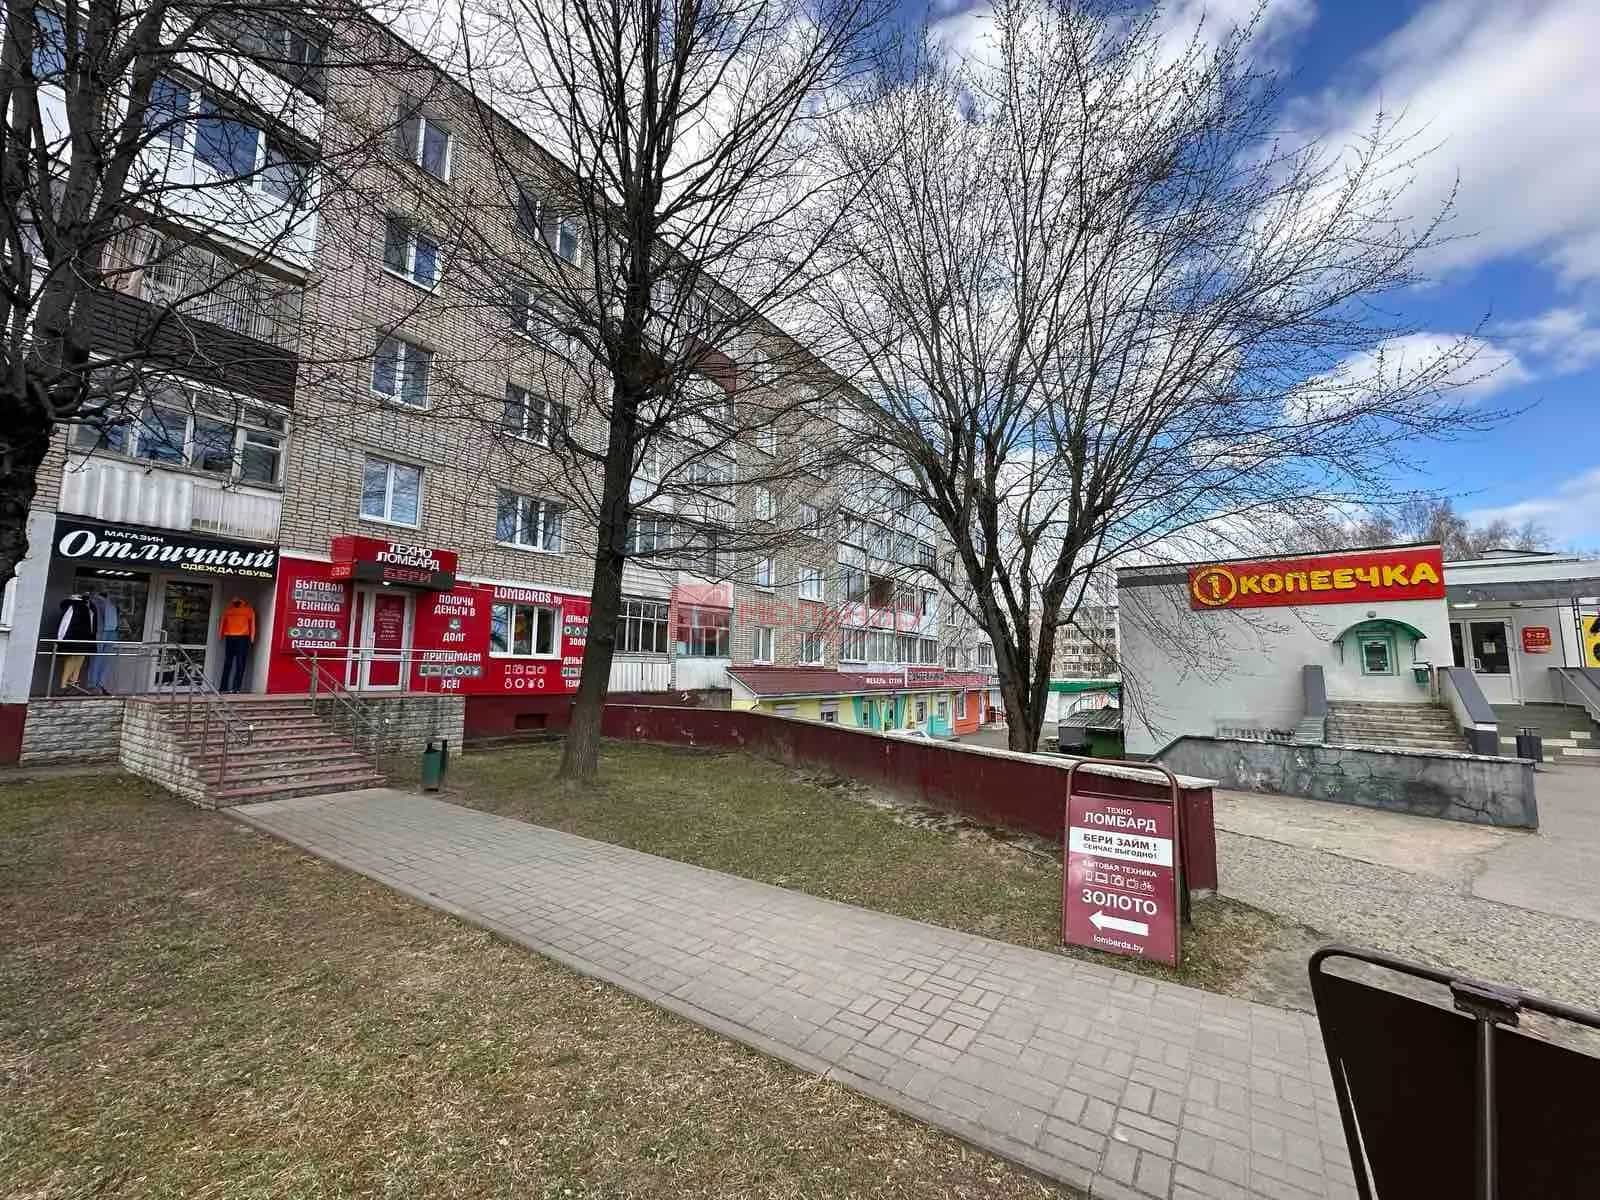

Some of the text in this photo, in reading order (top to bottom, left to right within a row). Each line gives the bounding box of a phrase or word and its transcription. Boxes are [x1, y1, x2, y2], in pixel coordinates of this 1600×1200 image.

[104, 530, 164, 543] МАГАЗИН
[59, 530, 275, 568] Отличный
[387, 542, 433, 558] ТЕХНО
[376, 551, 440, 571] ЛОМБАРД
[180, 562, 273, 578] ОДЕЖДА ОБУВЬ
[1239, 562, 1440, 595] КОПЕЕЧКА
[295, 579, 344, 592] БЫТОВАЯ
[295, 600, 340, 612] ТЕХНИКА
[439, 594, 474, 607] ПОЛУЧИ
[434, 604, 476, 616] ДЕНЬГИ В
[296, 618, 336, 628] ЗОЛОТО
[442, 632, 466, 642] ДОЛГ
[1106, 806, 1133, 815] ТЕХНО
[1084, 811, 1157, 833] ЛОМБАРД
[1083, 833, 1113, 845] БЕРИ
[1116, 838, 1150, 850] ЗАЙМ
[1122, 866, 1158, 877] ТЕХНИКА
[1082, 888, 1158, 915] ЗОЛОТО
